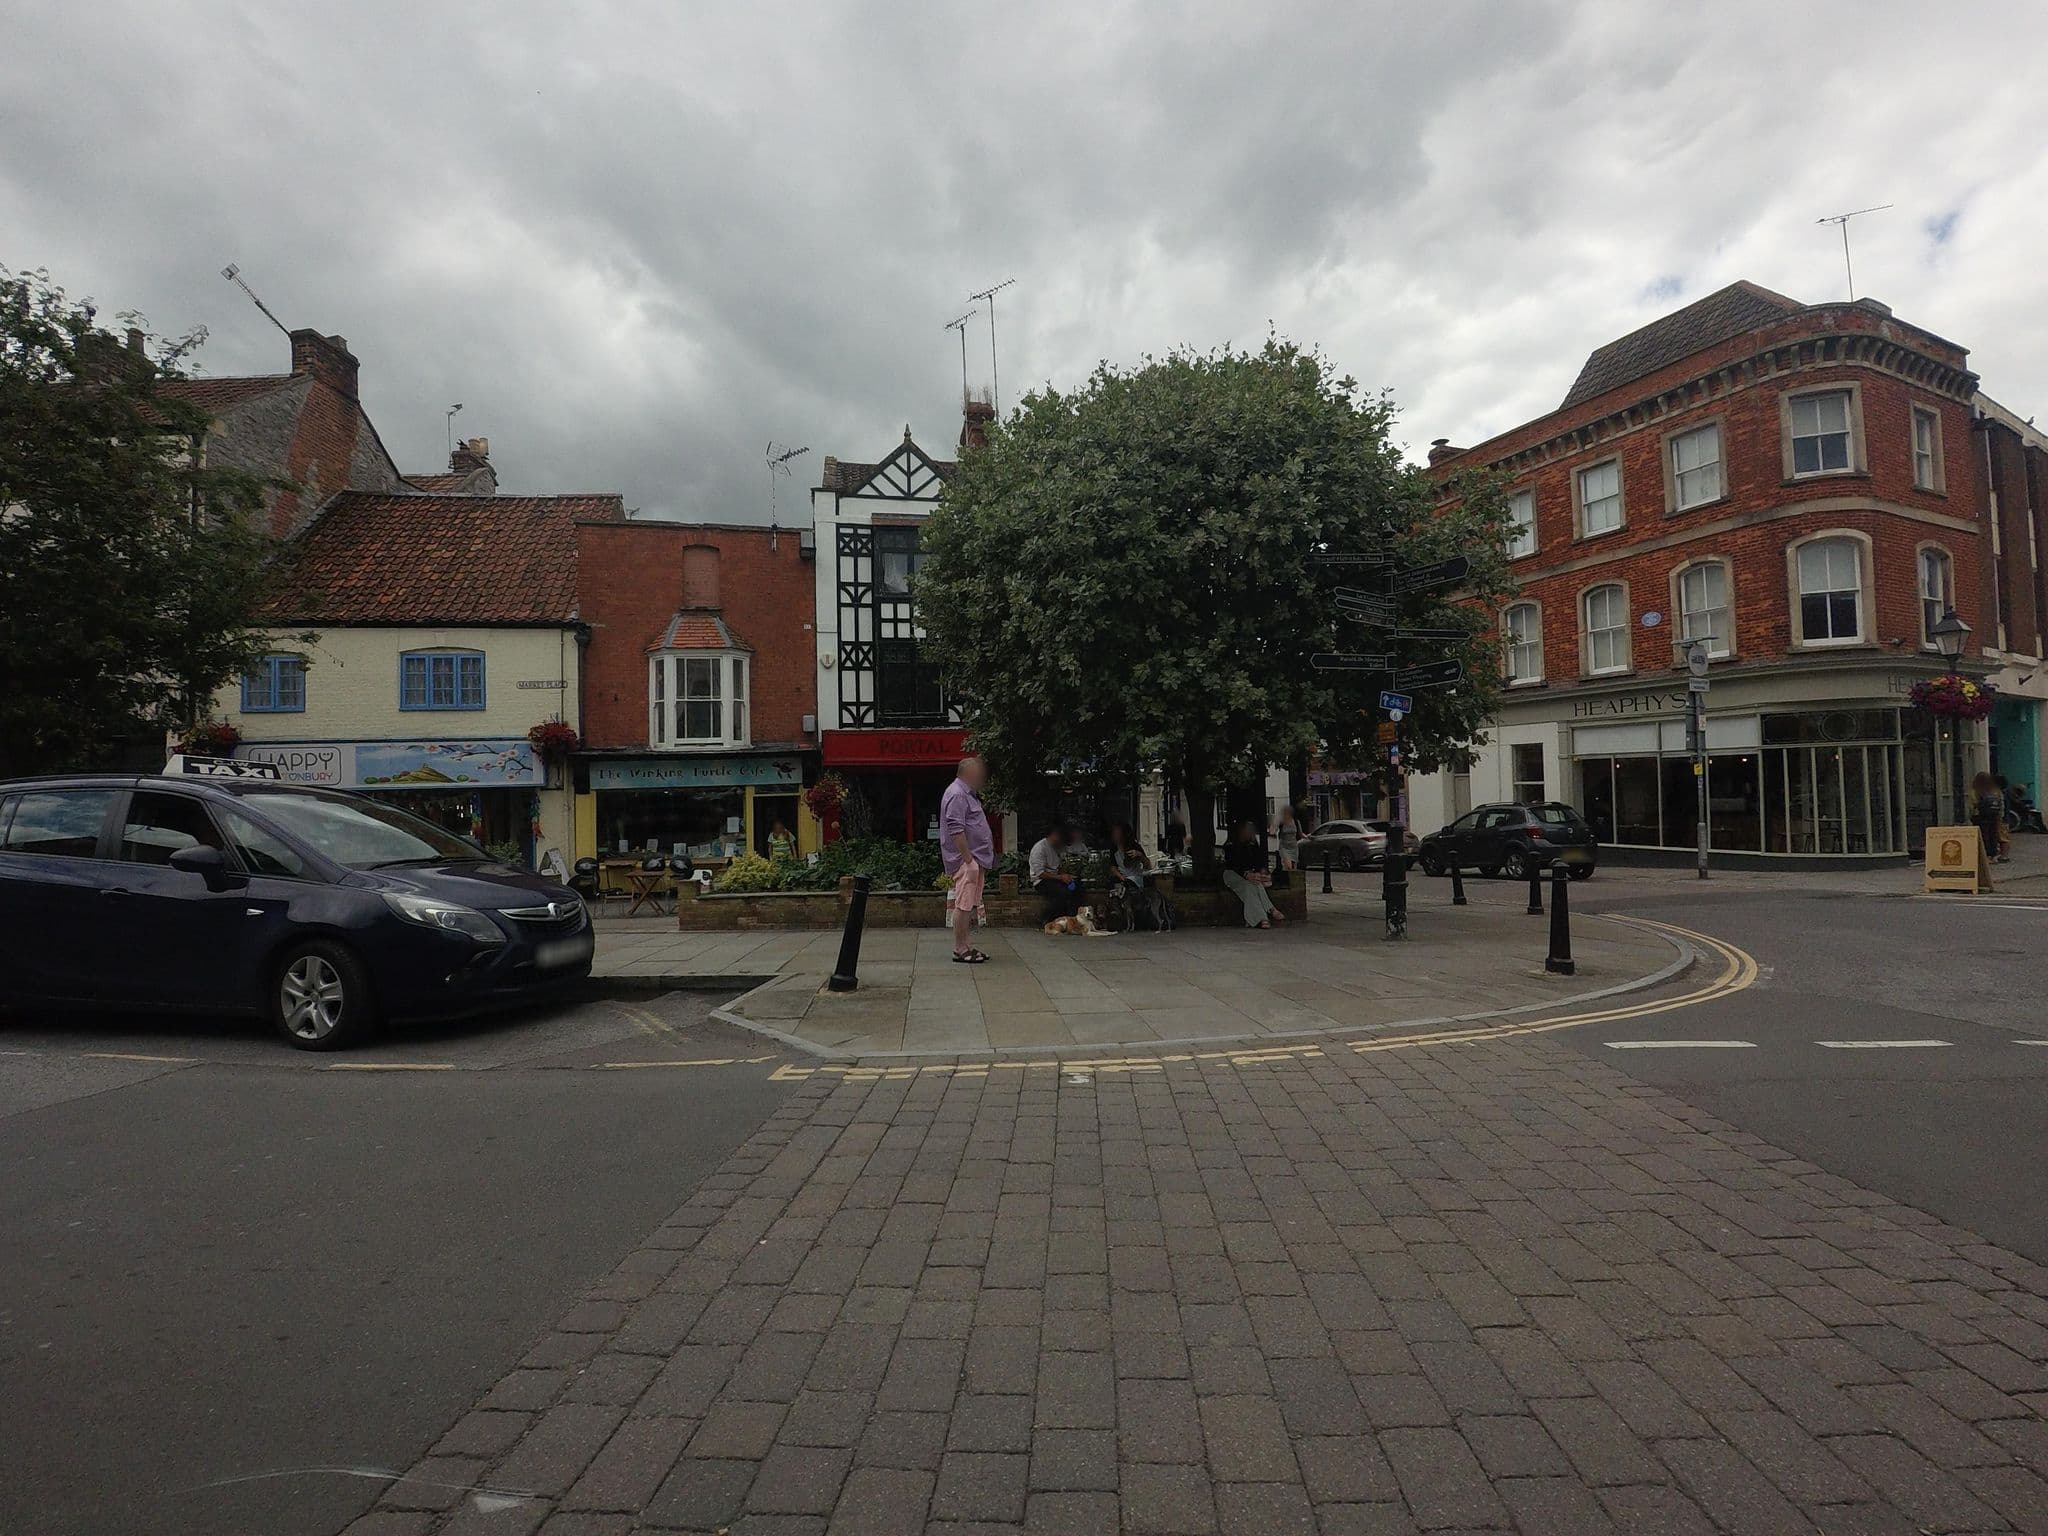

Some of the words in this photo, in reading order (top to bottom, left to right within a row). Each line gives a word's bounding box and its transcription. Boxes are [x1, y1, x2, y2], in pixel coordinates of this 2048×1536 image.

[1574, 692, 1687, 716] HEAPHY'S
[191, 763, 274, 779] TAXI
[258, 752, 334, 771] HAPPY
